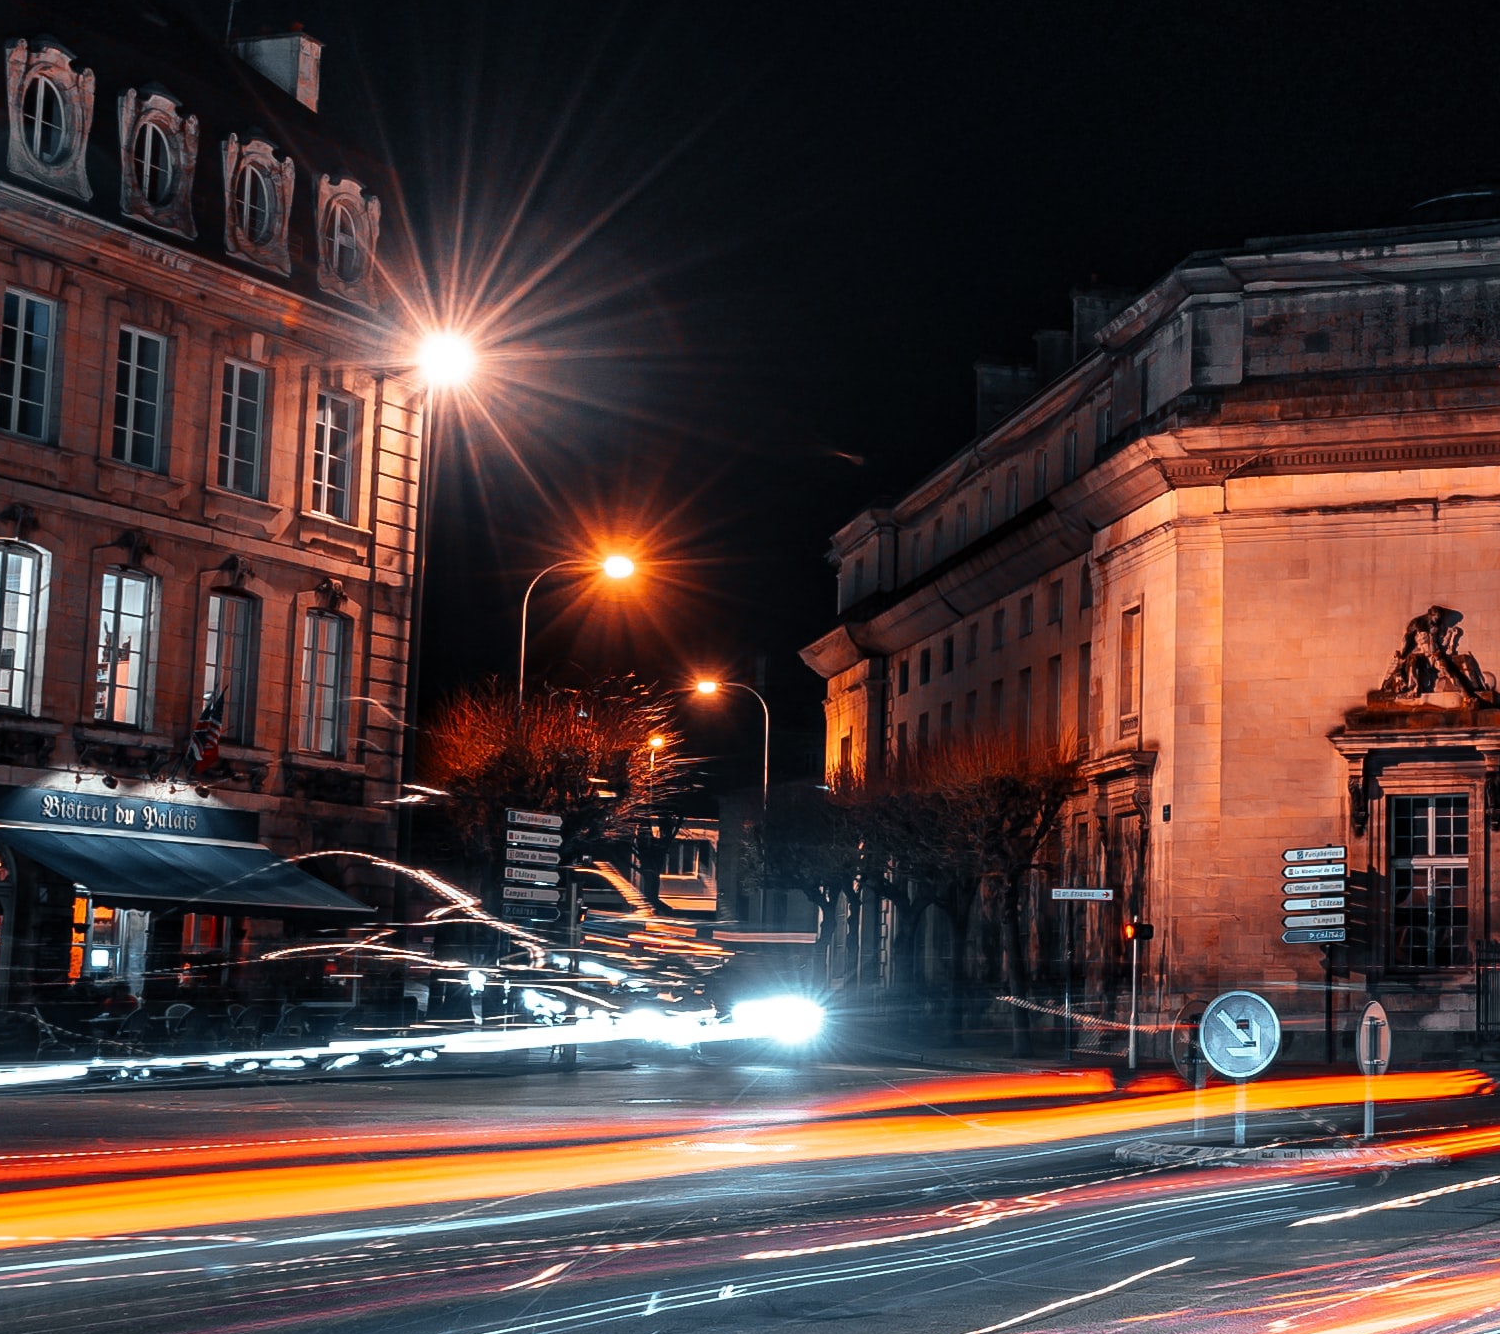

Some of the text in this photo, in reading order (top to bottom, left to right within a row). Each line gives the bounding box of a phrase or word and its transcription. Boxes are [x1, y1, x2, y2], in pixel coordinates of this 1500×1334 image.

[41, 794, 198, 832] Bistrot du Palais
[505, 889, 527, 897] Campus
